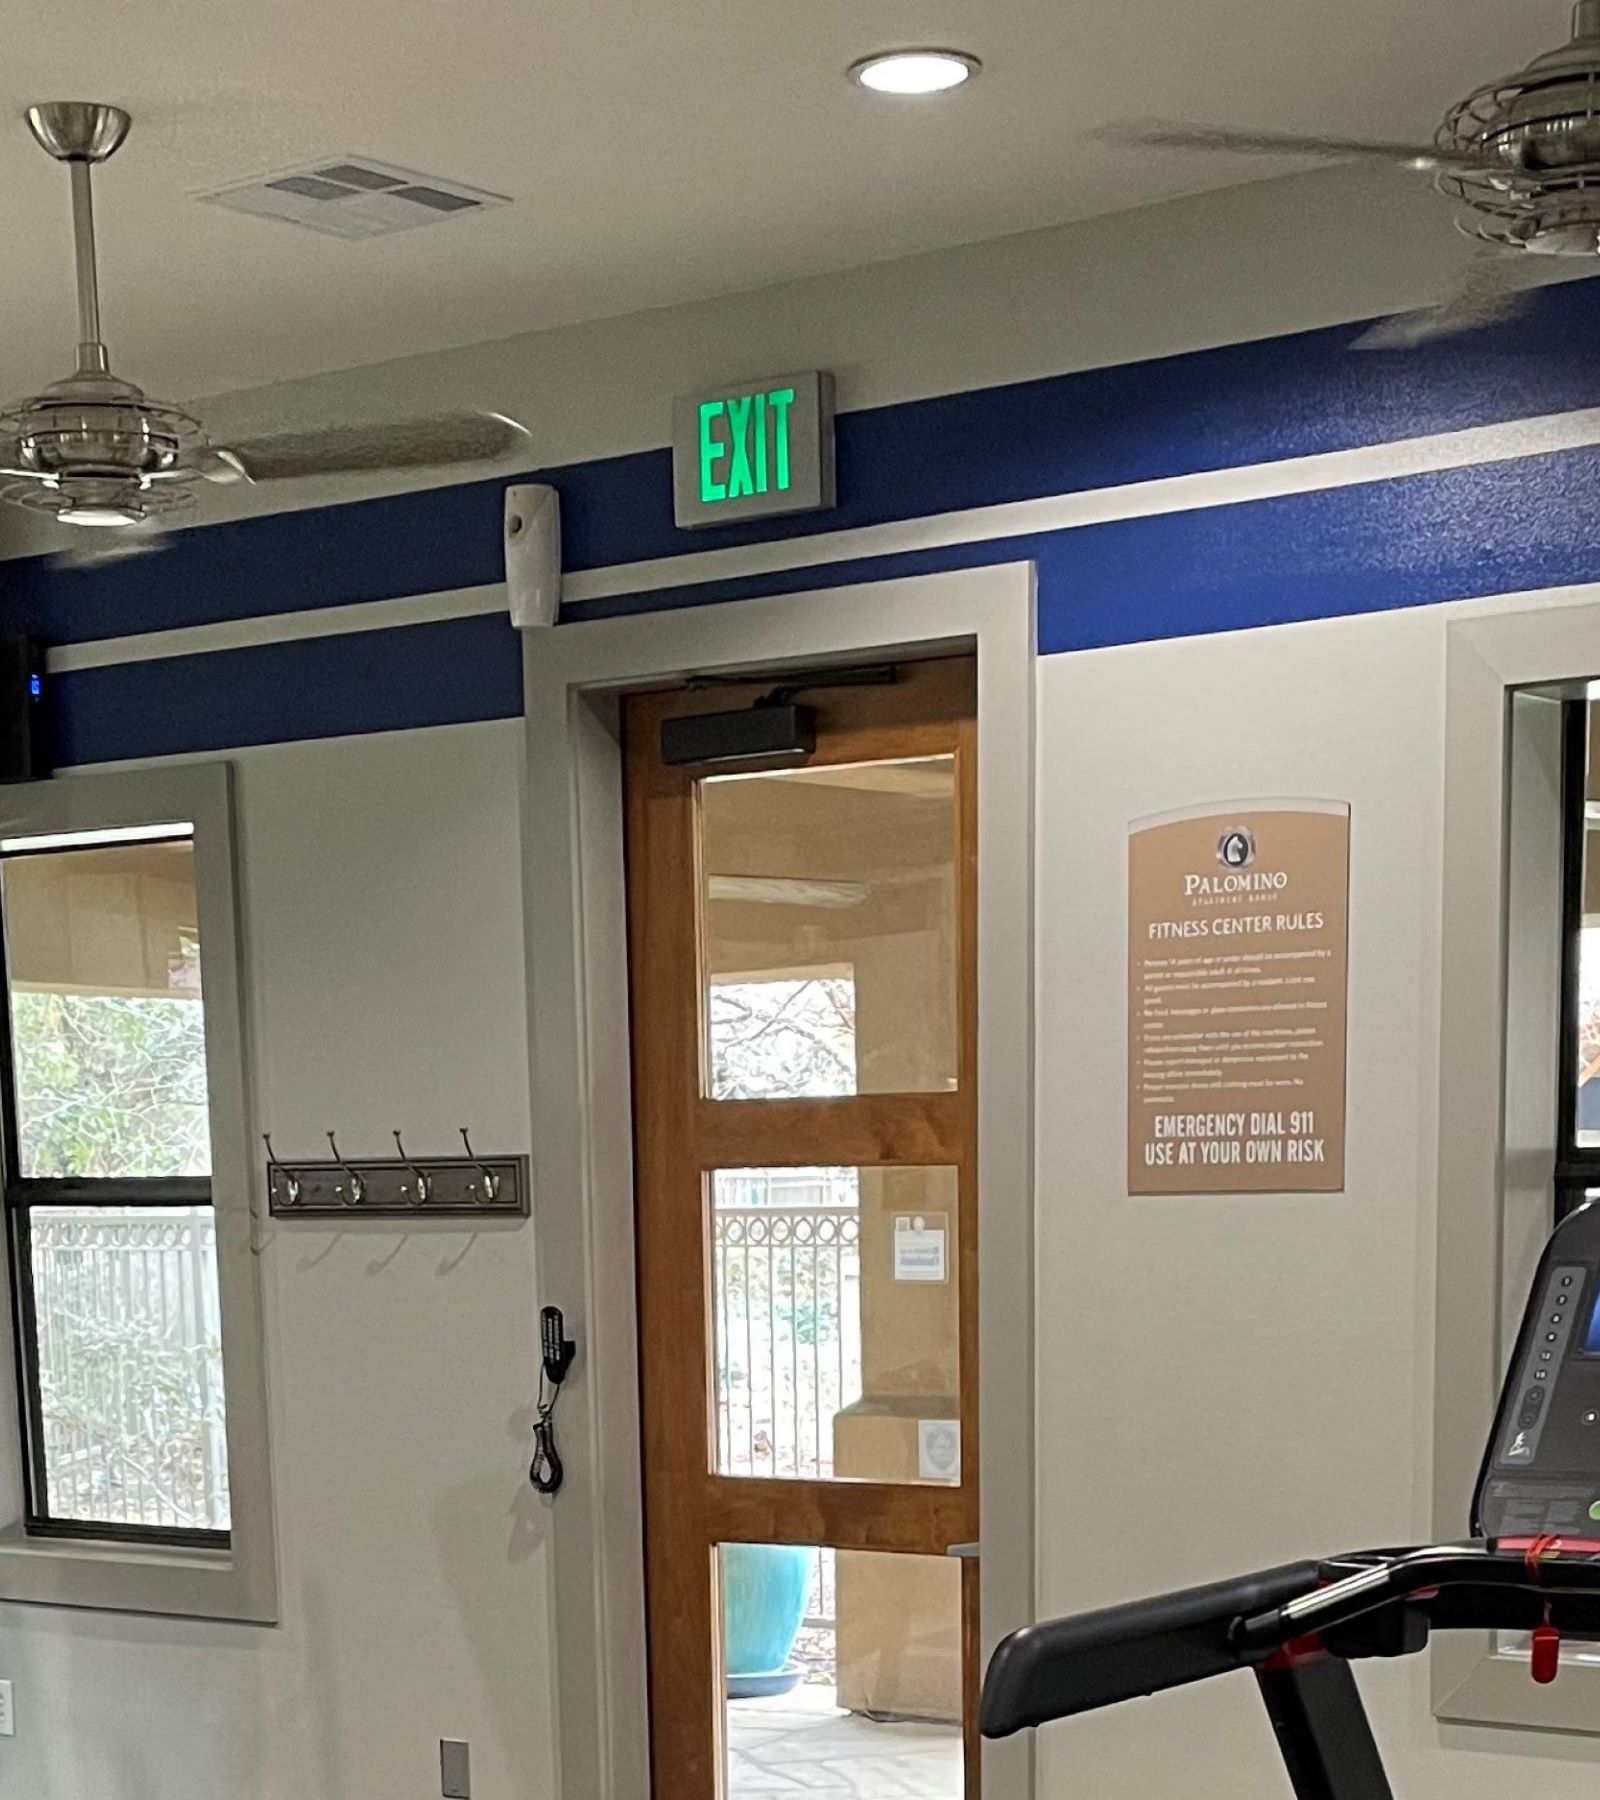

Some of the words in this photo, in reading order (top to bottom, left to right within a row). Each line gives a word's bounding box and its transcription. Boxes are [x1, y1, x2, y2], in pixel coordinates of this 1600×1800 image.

[700, 388, 794, 502] EXIT
[1184, 872, 1288, 895] PALOMINO
[1149, 920, 1209, 939] FITNESS
[1212, 916, 1272, 935] CENTER
[1276, 912, 1324, 930] RULES
[1154, 1113, 1246, 1138] EMERGENCY
[1250, 1112, 1285, 1135] DIAL
[1290, 1111, 1314, 1135] 911
[1144, 1142, 1174, 1166] USE
[1178, 1141, 1197, 1164] AT
[1200, 1141, 1241, 1164] YOUR
[1245, 1139, 1281, 1163] OWN
[1287, 1138, 1325, 1162] RISK
